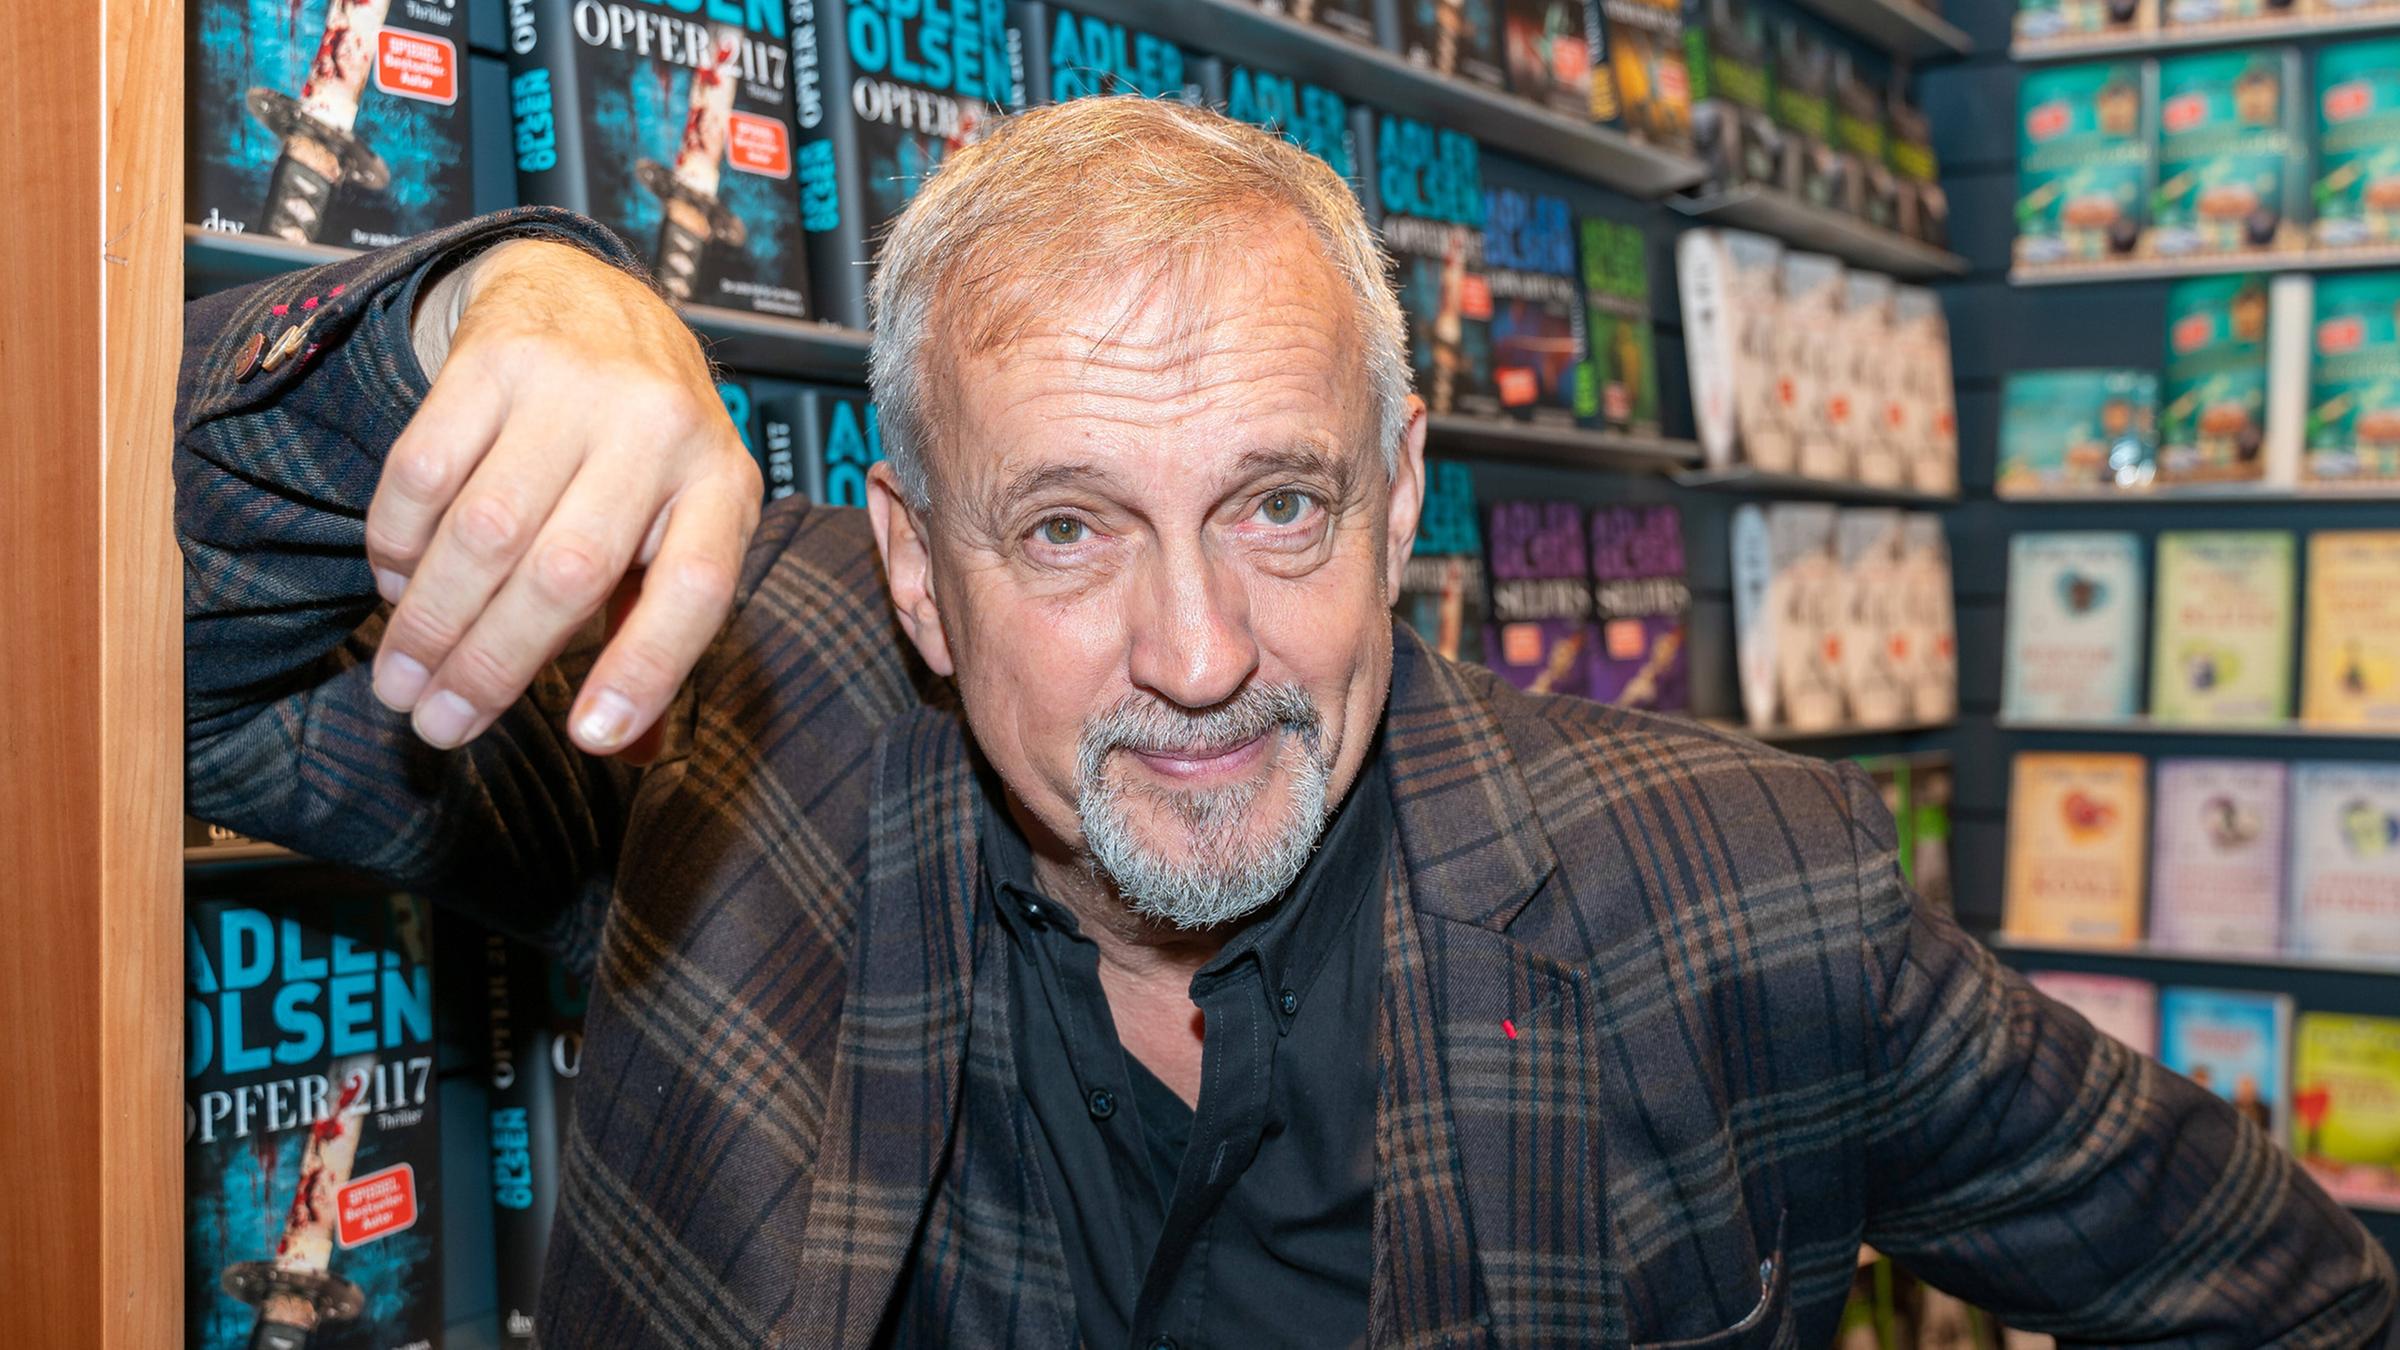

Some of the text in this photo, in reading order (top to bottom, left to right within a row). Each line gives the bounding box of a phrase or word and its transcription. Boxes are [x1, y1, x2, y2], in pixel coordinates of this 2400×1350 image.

[573, 0, 711, 68] OPFER
[716, 24, 787, 90] 2117
[849, 5, 1013, 106] OLSEN
[1051, 9, 1184, 92] ADLER
[852, 76, 961, 138] OPFER
[187, 908, 402, 994] ADLE
[338, 1056, 432, 1119] 2117
